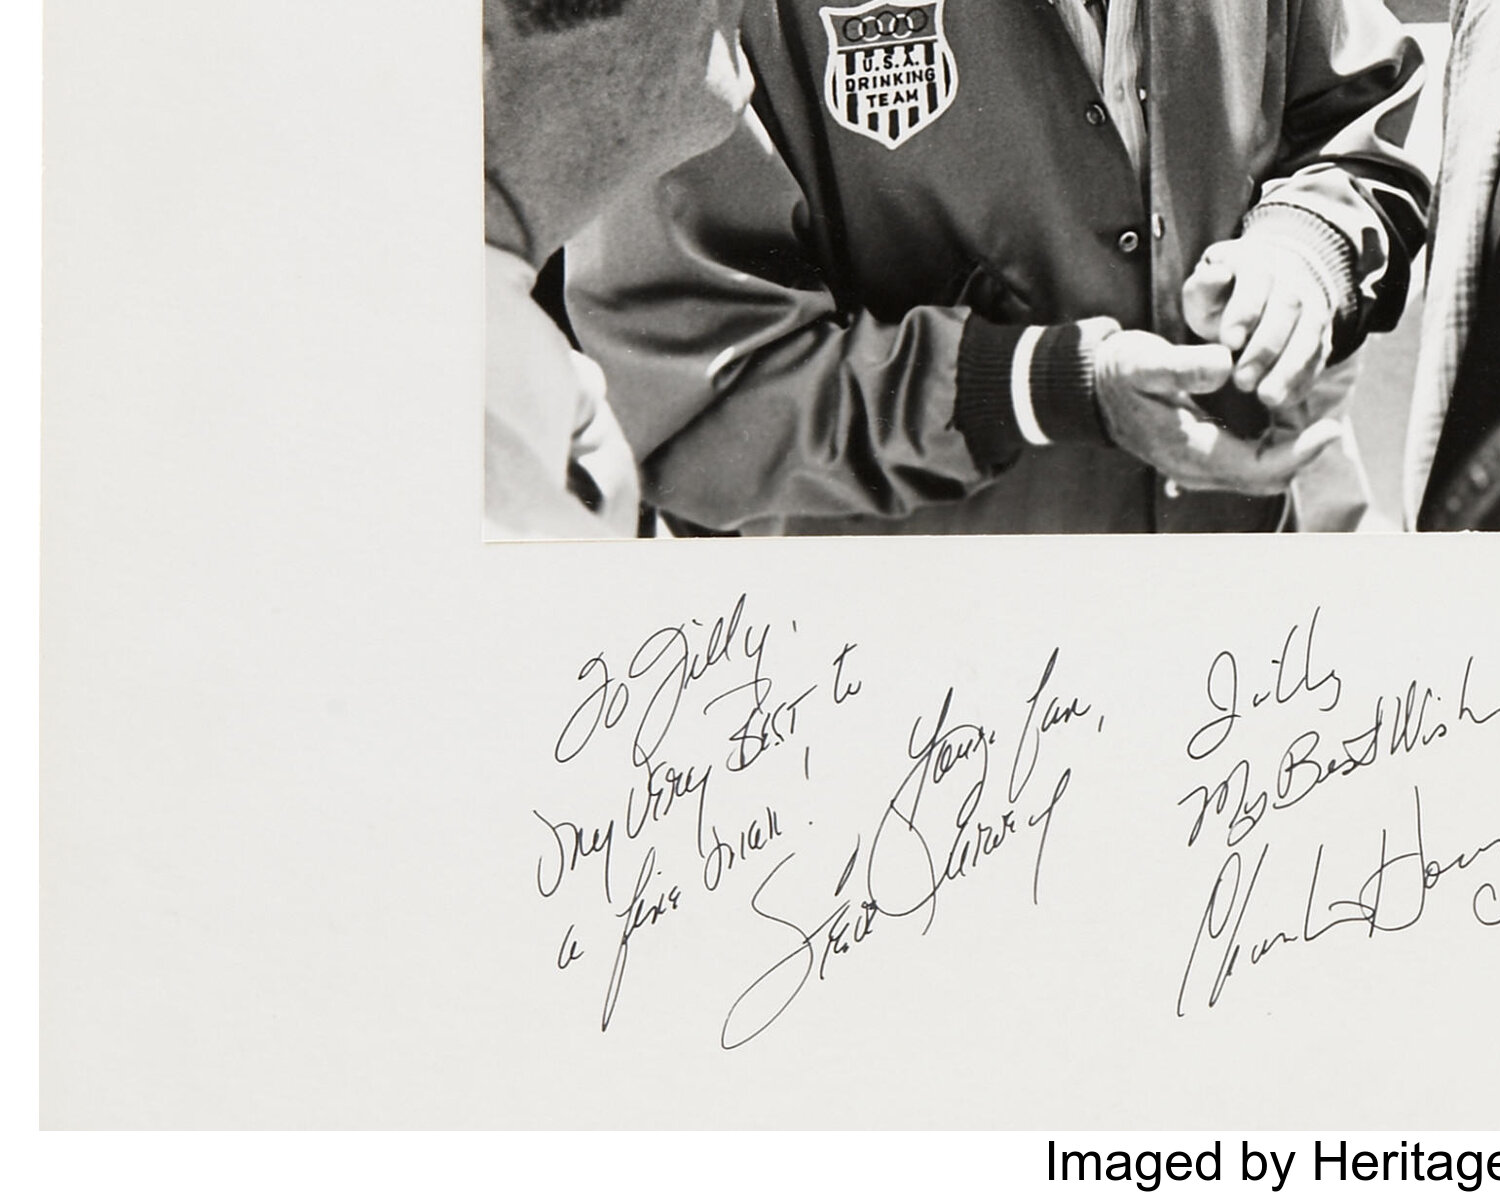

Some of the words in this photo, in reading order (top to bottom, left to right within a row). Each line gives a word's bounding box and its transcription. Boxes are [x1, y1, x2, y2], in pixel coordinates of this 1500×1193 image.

[863, 53, 920, 73] U.S.A.
[845, 67, 936, 93] DRINKING
[866, 88, 920, 109] TEAM
